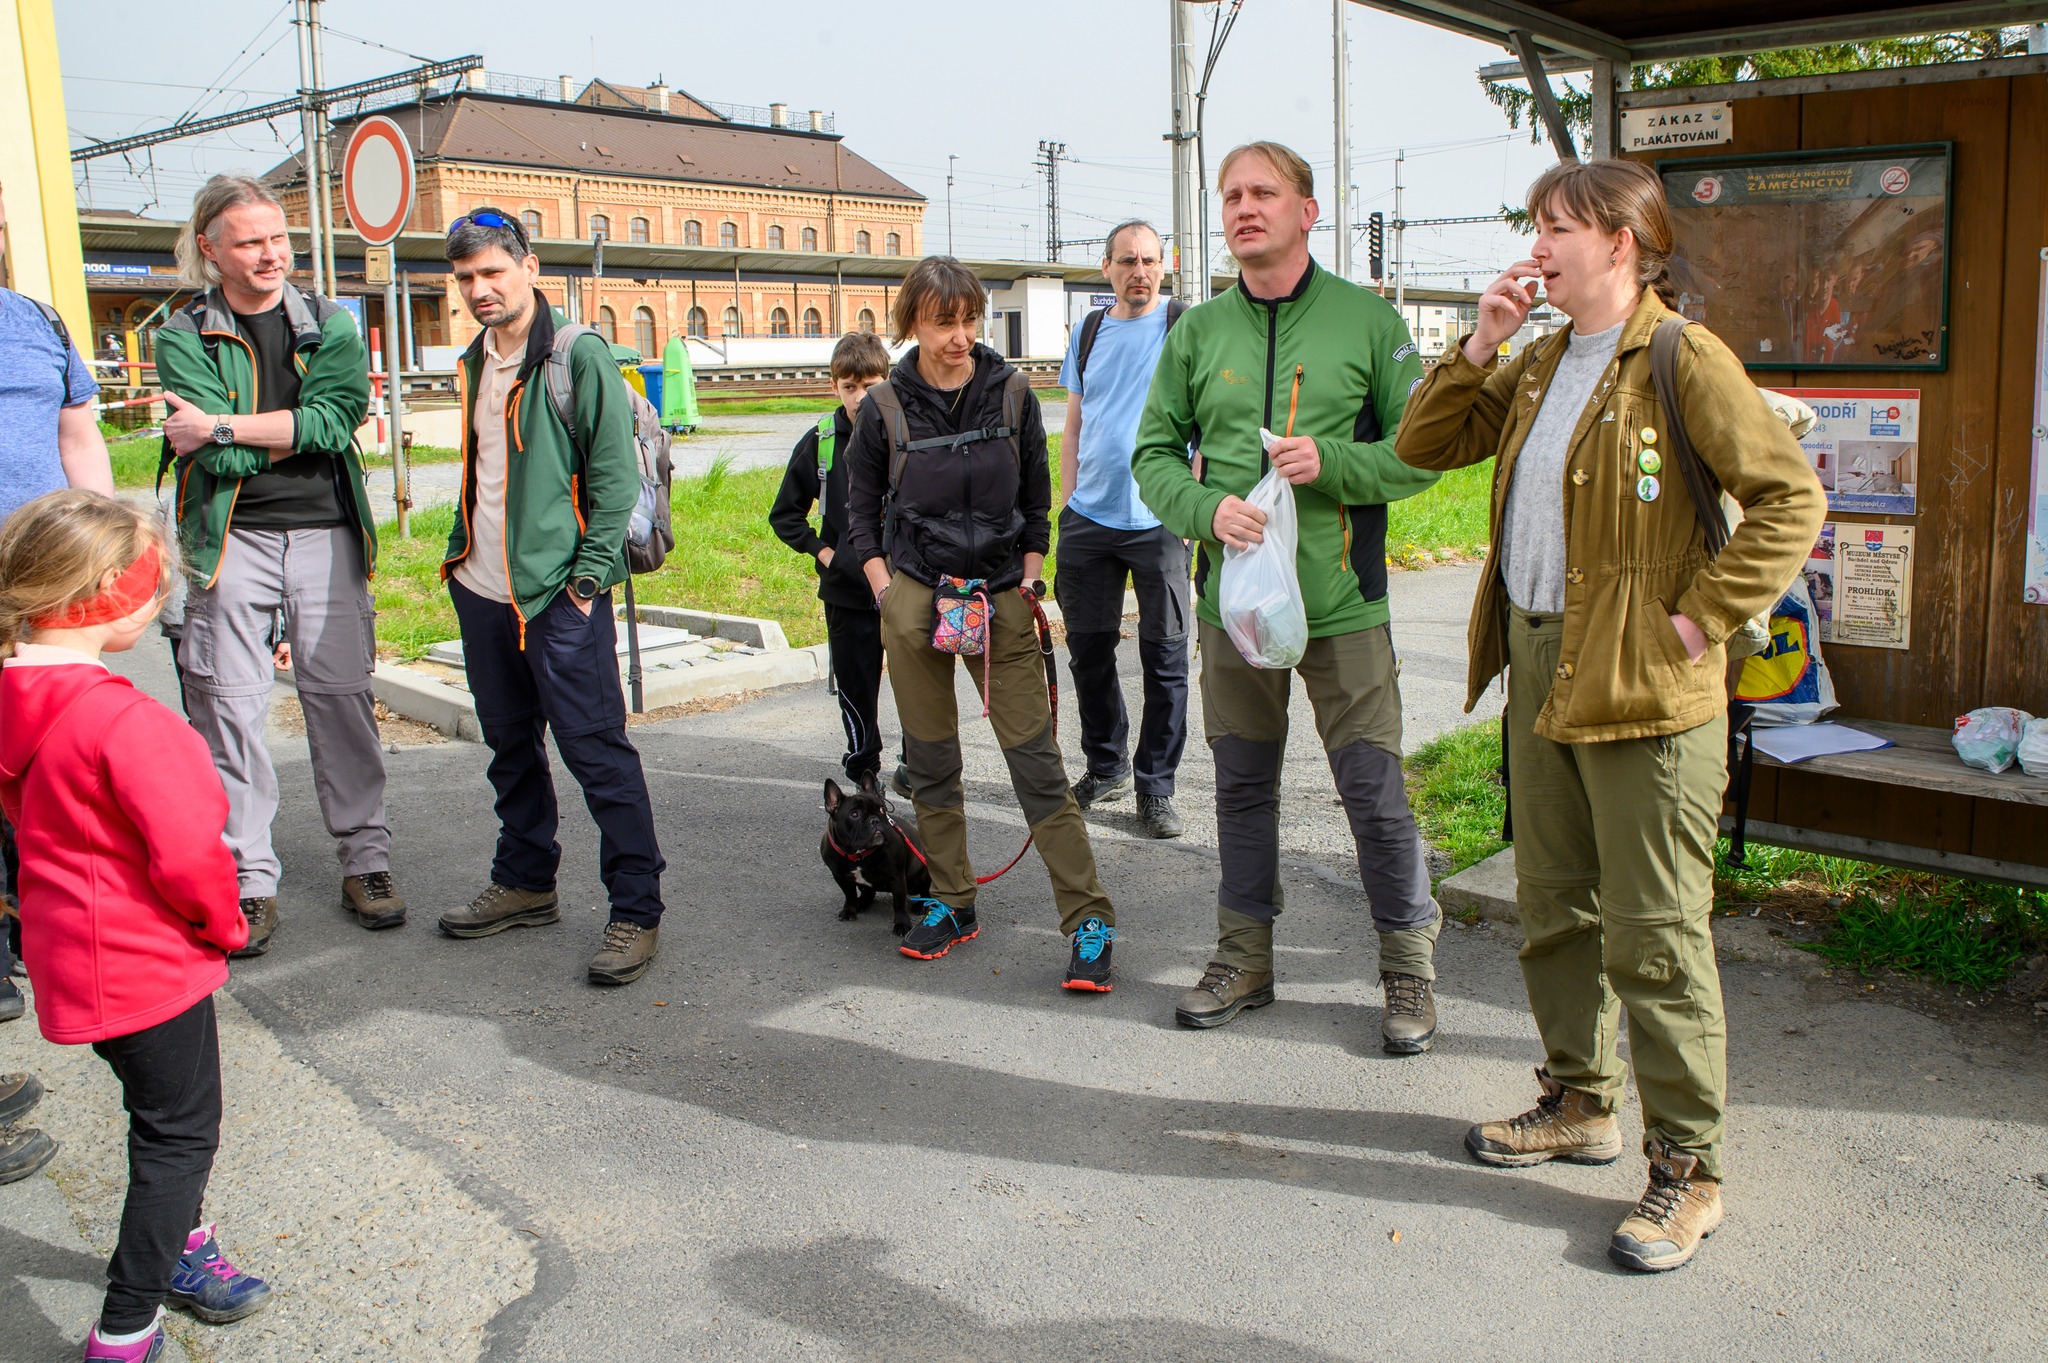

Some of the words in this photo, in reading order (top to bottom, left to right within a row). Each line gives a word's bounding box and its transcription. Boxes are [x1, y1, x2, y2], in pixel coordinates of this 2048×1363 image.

[1647, 113, 1703, 127] ZÁKAZ
[1633, 128, 1719, 147] PLAKÁTOVÁNÍ
[1747, 176, 1854, 191] ZÁMEČNICTVÍ
[1093, 296, 1116, 305] Suchdol
[1811, 402, 1857, 419] OODŘÍ
[1873, 551, 1901, 559] MĚSTYSE
[1847, 586, 1896, 597] PROHLÍDKA
